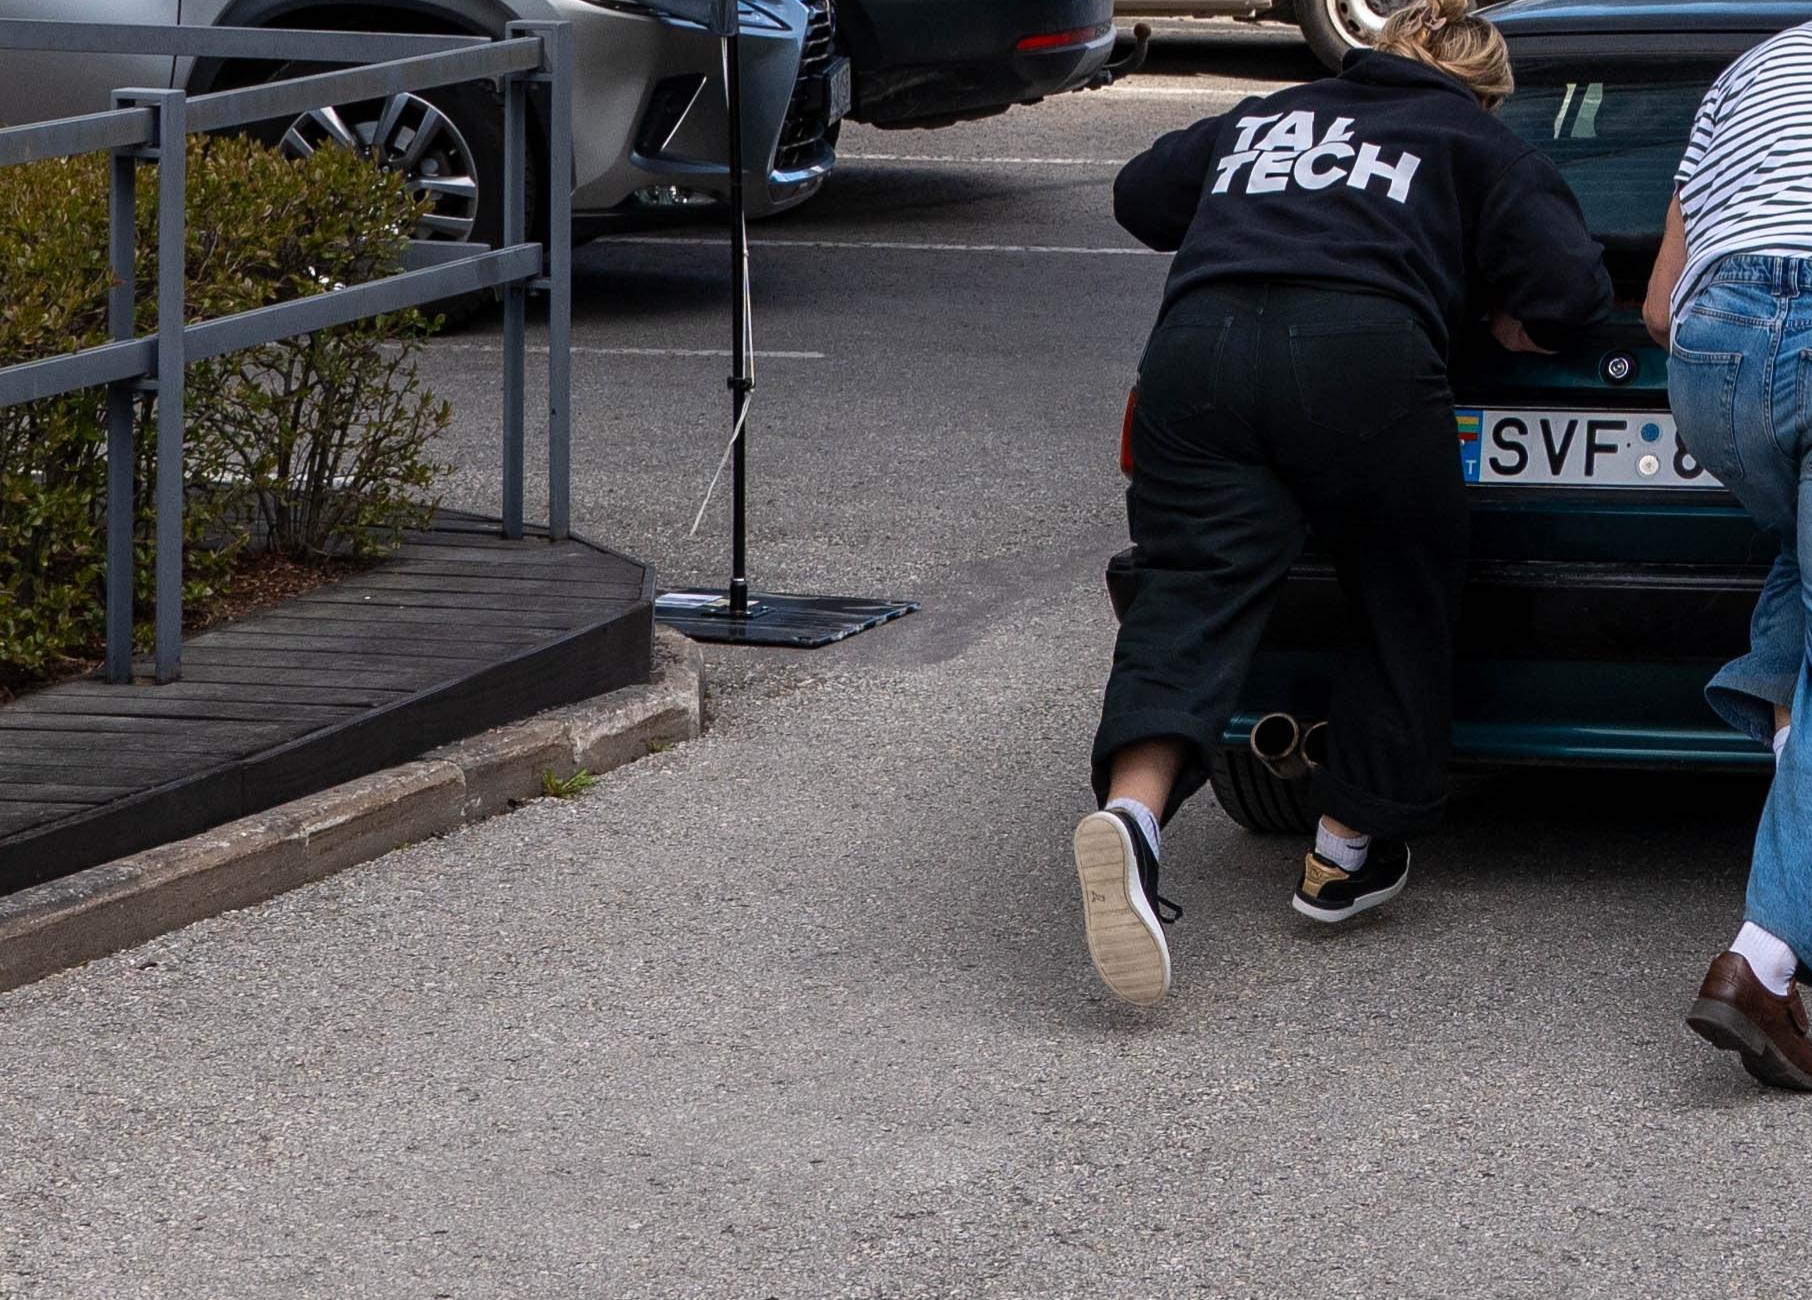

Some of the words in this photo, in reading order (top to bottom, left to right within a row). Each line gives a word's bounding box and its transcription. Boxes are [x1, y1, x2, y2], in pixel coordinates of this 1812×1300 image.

[1233, 110, 1355, 153] TAL
[1210, 140, 1421, 204] TECH
[1488, 417, 1628, 477] SVF
